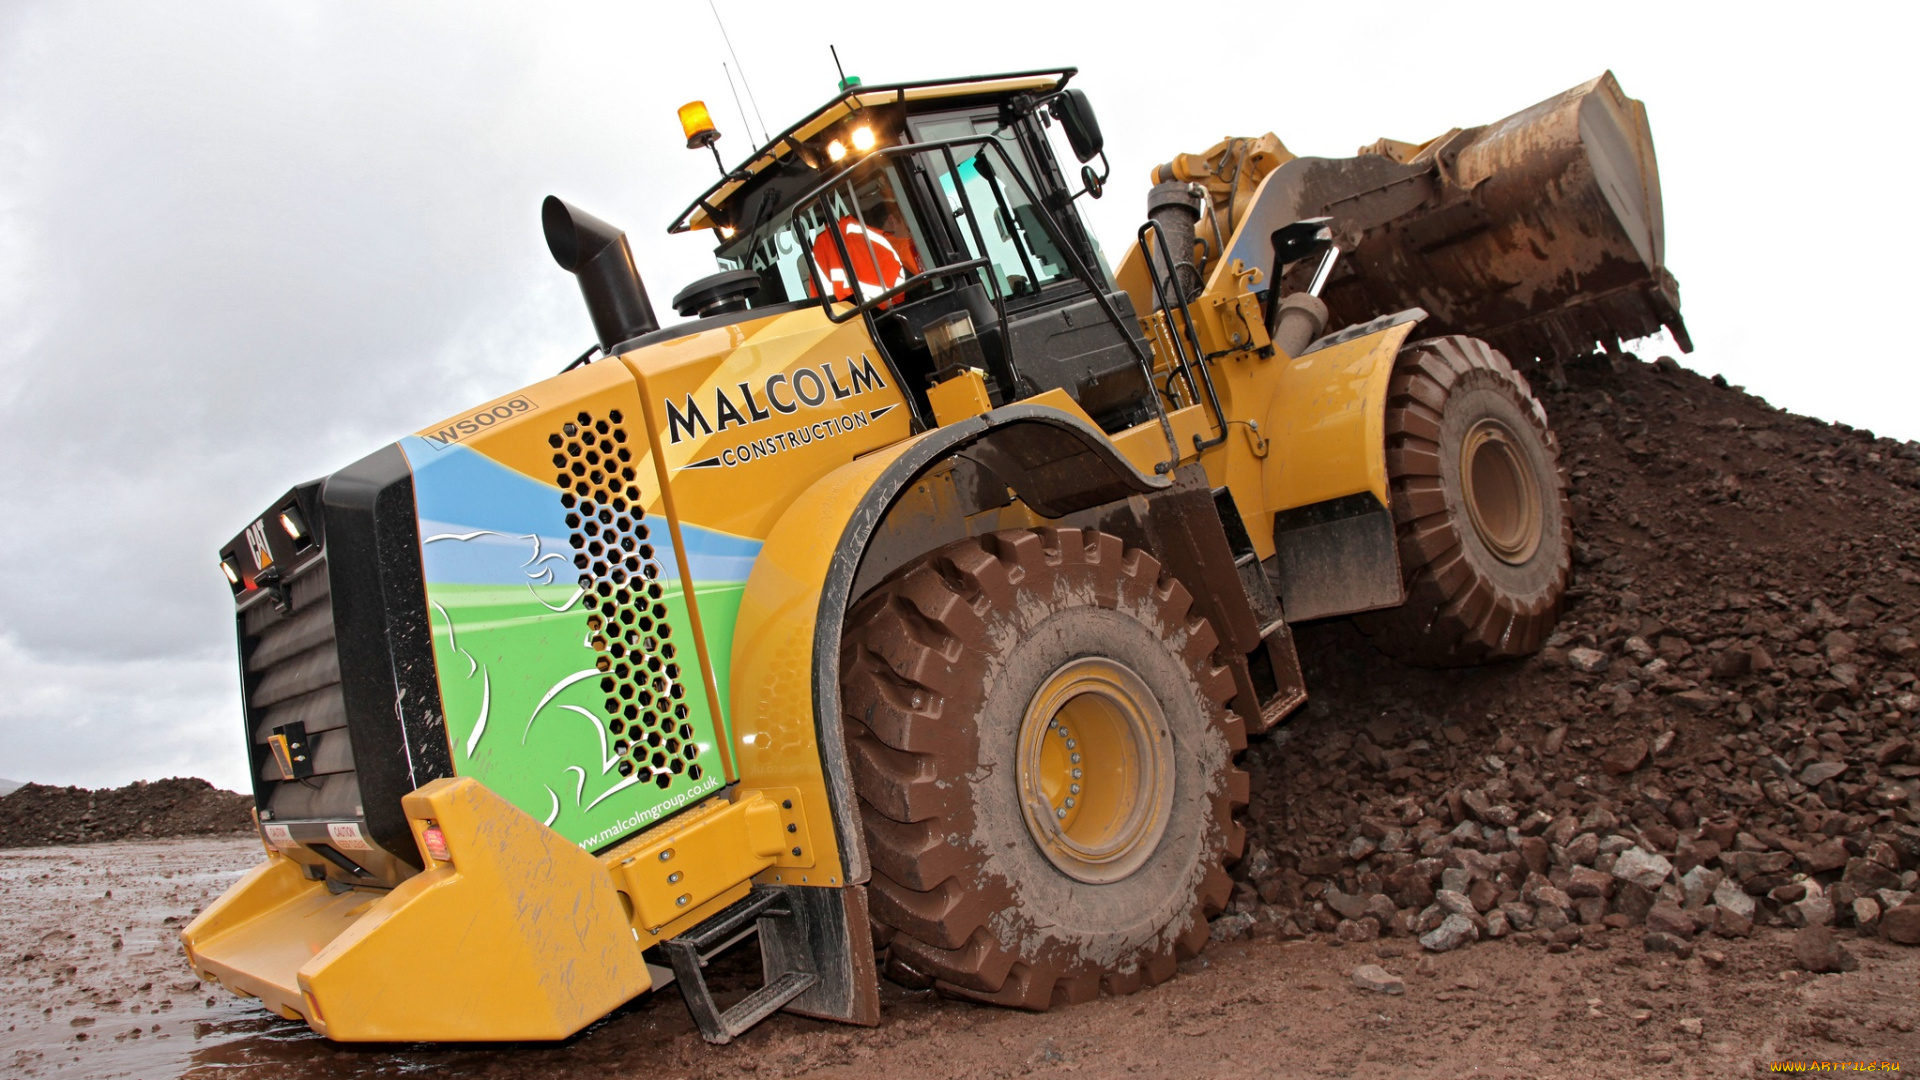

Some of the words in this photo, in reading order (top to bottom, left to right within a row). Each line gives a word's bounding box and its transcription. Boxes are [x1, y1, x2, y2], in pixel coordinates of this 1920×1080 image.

[665, 353, 887, 445] MALCOLM
[722, 410, 868, 467] CONSTRUCTION
[245, 518, 274, 571] CAT
[333, 826, 356, 838] CAUTION
[578, 775, 718, 850] ww.malcolmgroup.co.uk
